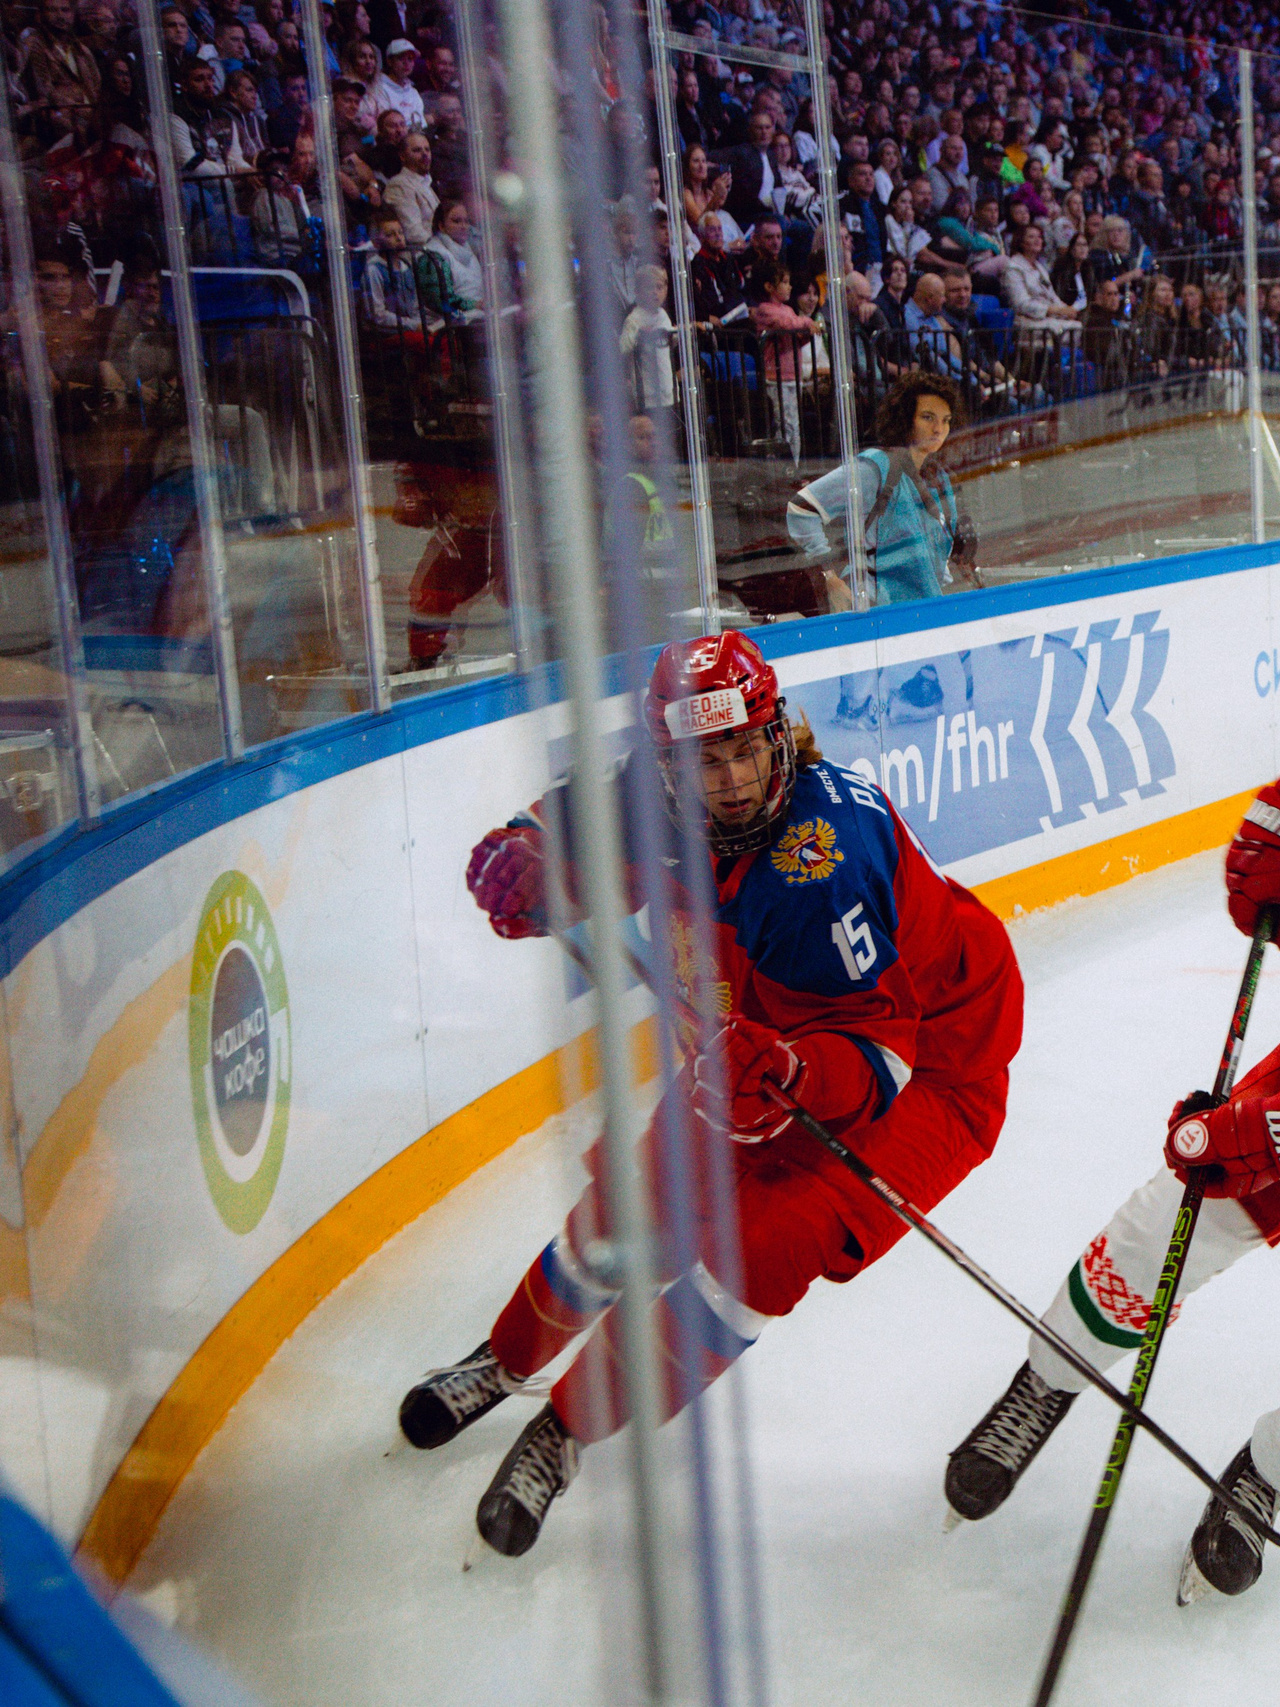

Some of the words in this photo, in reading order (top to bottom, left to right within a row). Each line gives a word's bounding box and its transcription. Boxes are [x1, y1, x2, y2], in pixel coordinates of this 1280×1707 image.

[678, 696, 712, 717] RED
[679, 707, 735, 730] MACHINE
[831, 902, 878, 980] 15
